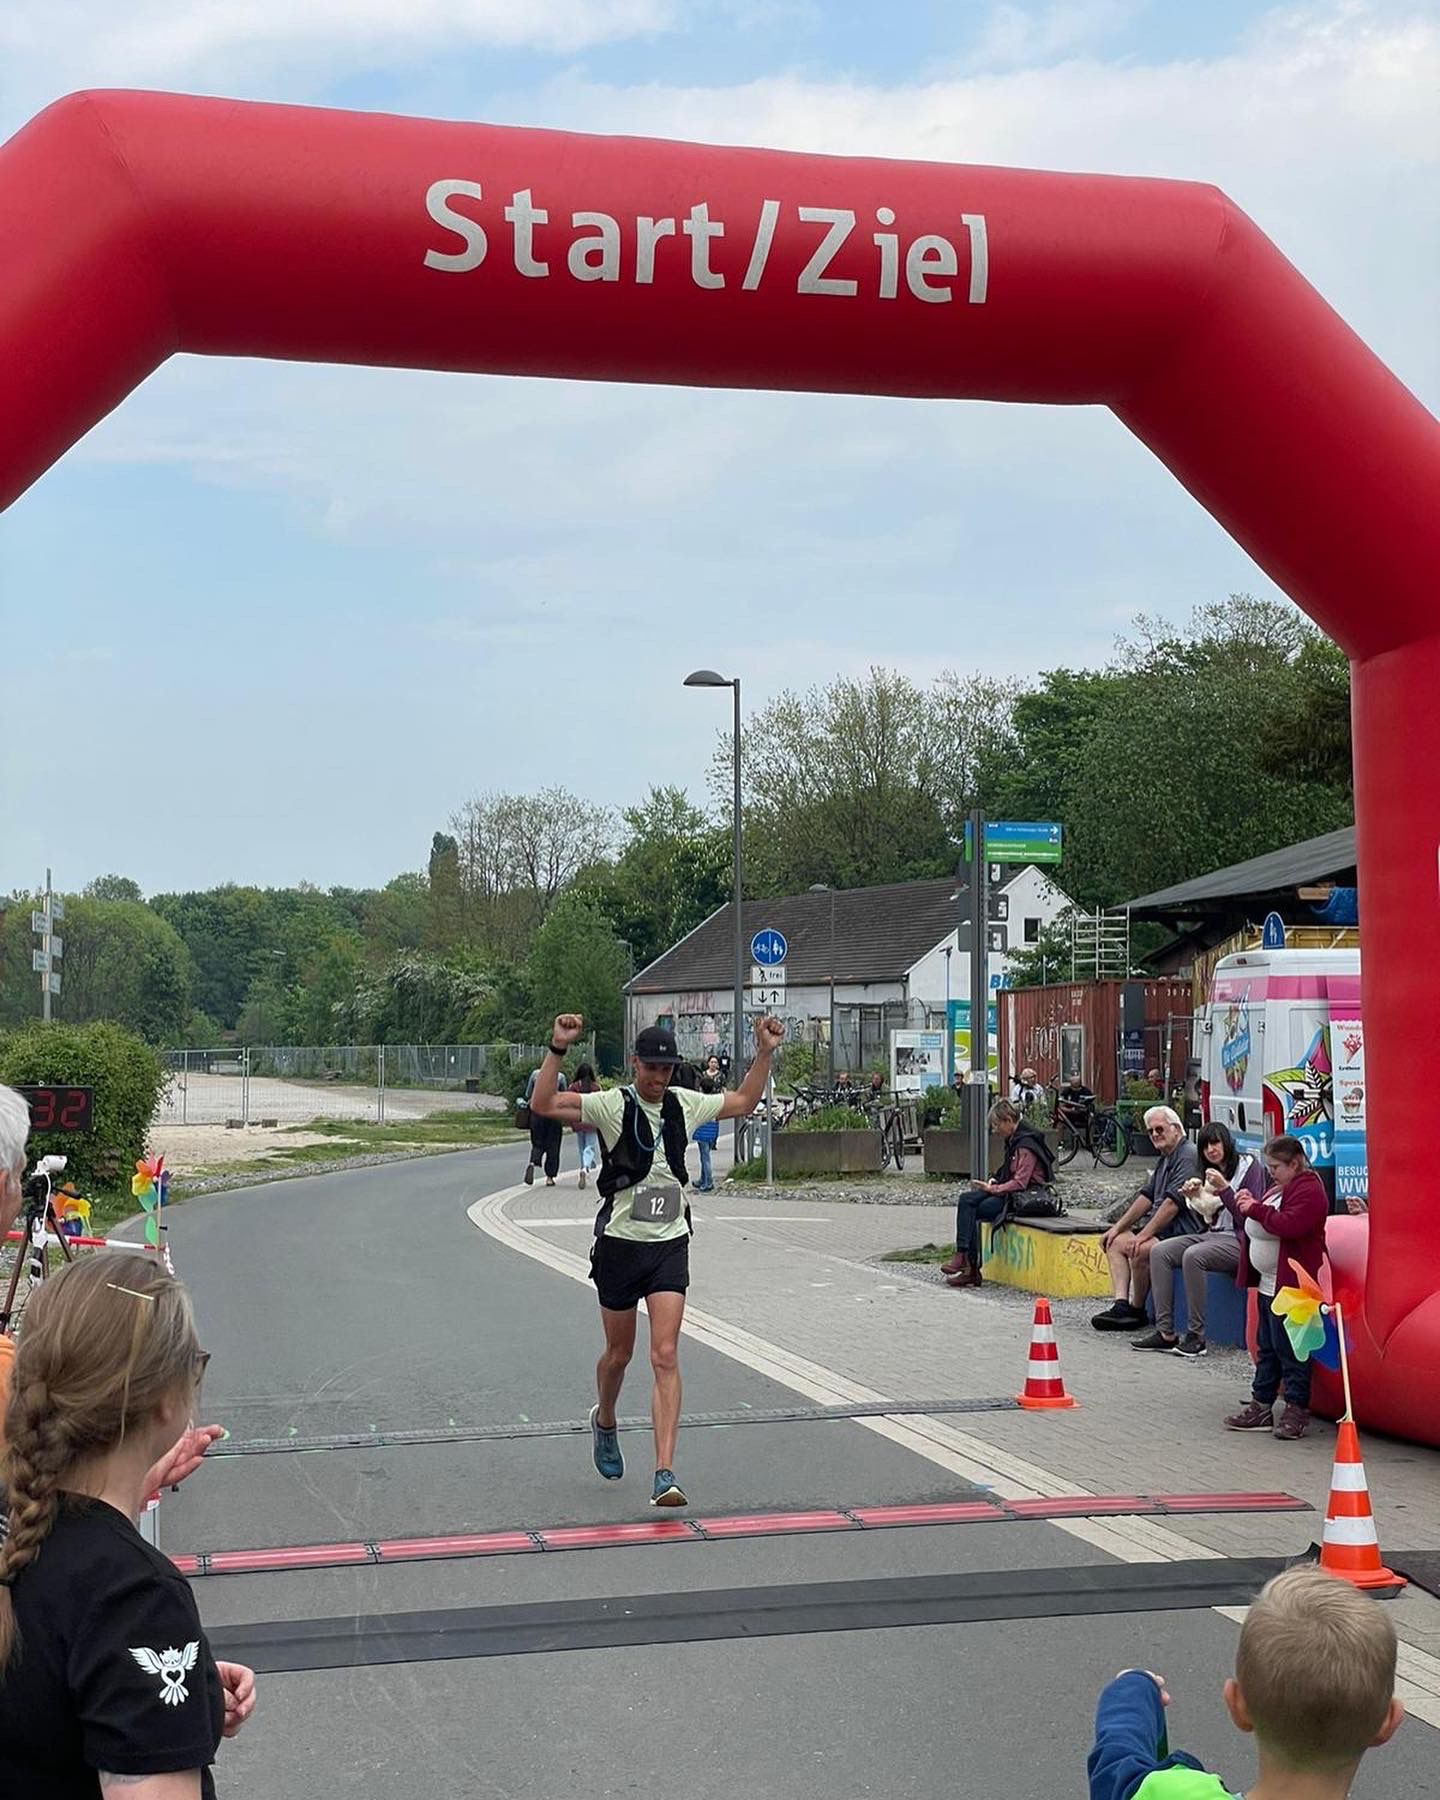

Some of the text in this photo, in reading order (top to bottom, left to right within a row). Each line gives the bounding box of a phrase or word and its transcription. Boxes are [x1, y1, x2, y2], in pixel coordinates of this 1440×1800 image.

[423, 178, 989, 304] Start/Ziel
[32, 1090, 87, 1129] 32
[650, 1196, 665, 1216] 12
